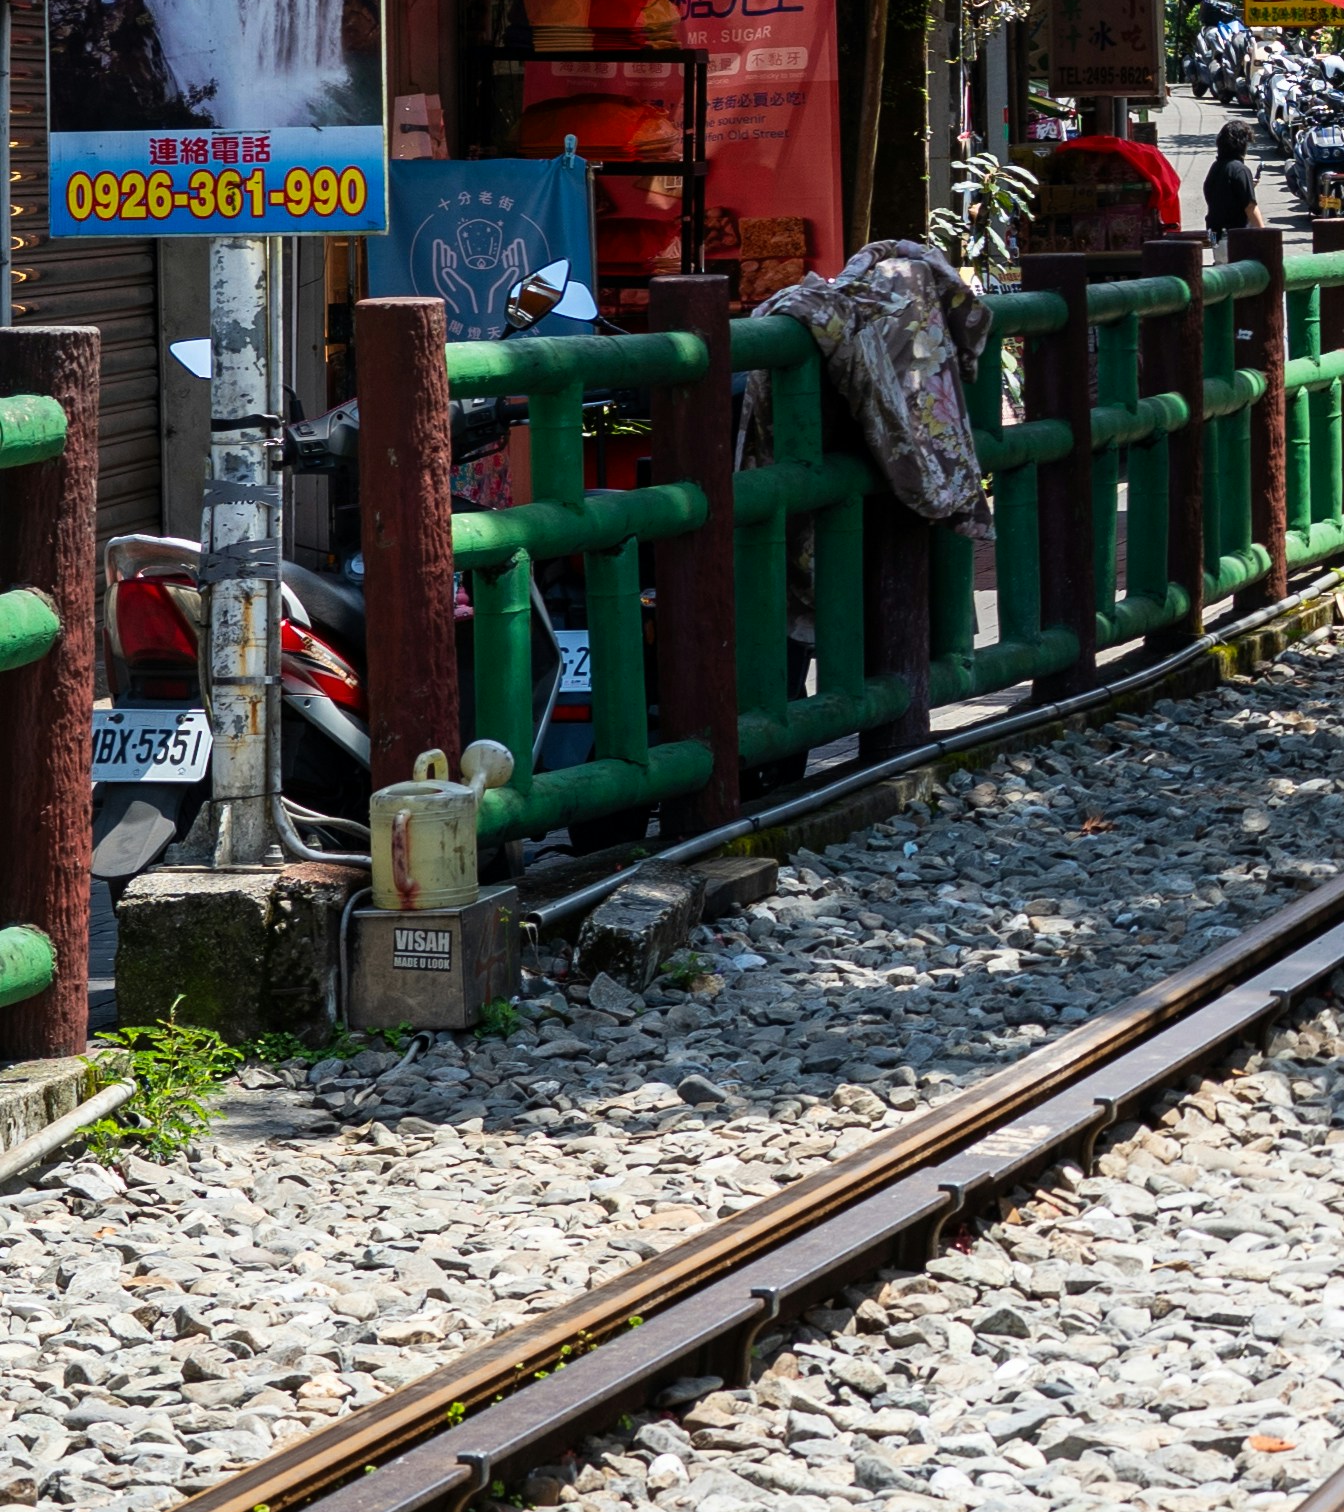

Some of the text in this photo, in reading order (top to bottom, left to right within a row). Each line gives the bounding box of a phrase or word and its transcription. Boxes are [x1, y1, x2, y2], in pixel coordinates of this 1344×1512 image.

[721, 26, 772, 43] SUGAR
[718, 115, 766, 127] souvenir
[728, 129, 748, 140] Old
[753, 129, 790, 140] Street
[149, 136, 272, 165] 連絡電話
[66, 166, 367, 220] 0926-361-990
[438, 191, 515, 212] 十分老街
[395, 929, 450, 953] VISAH
[394, 956, 451, 970] MADE U LOOK
